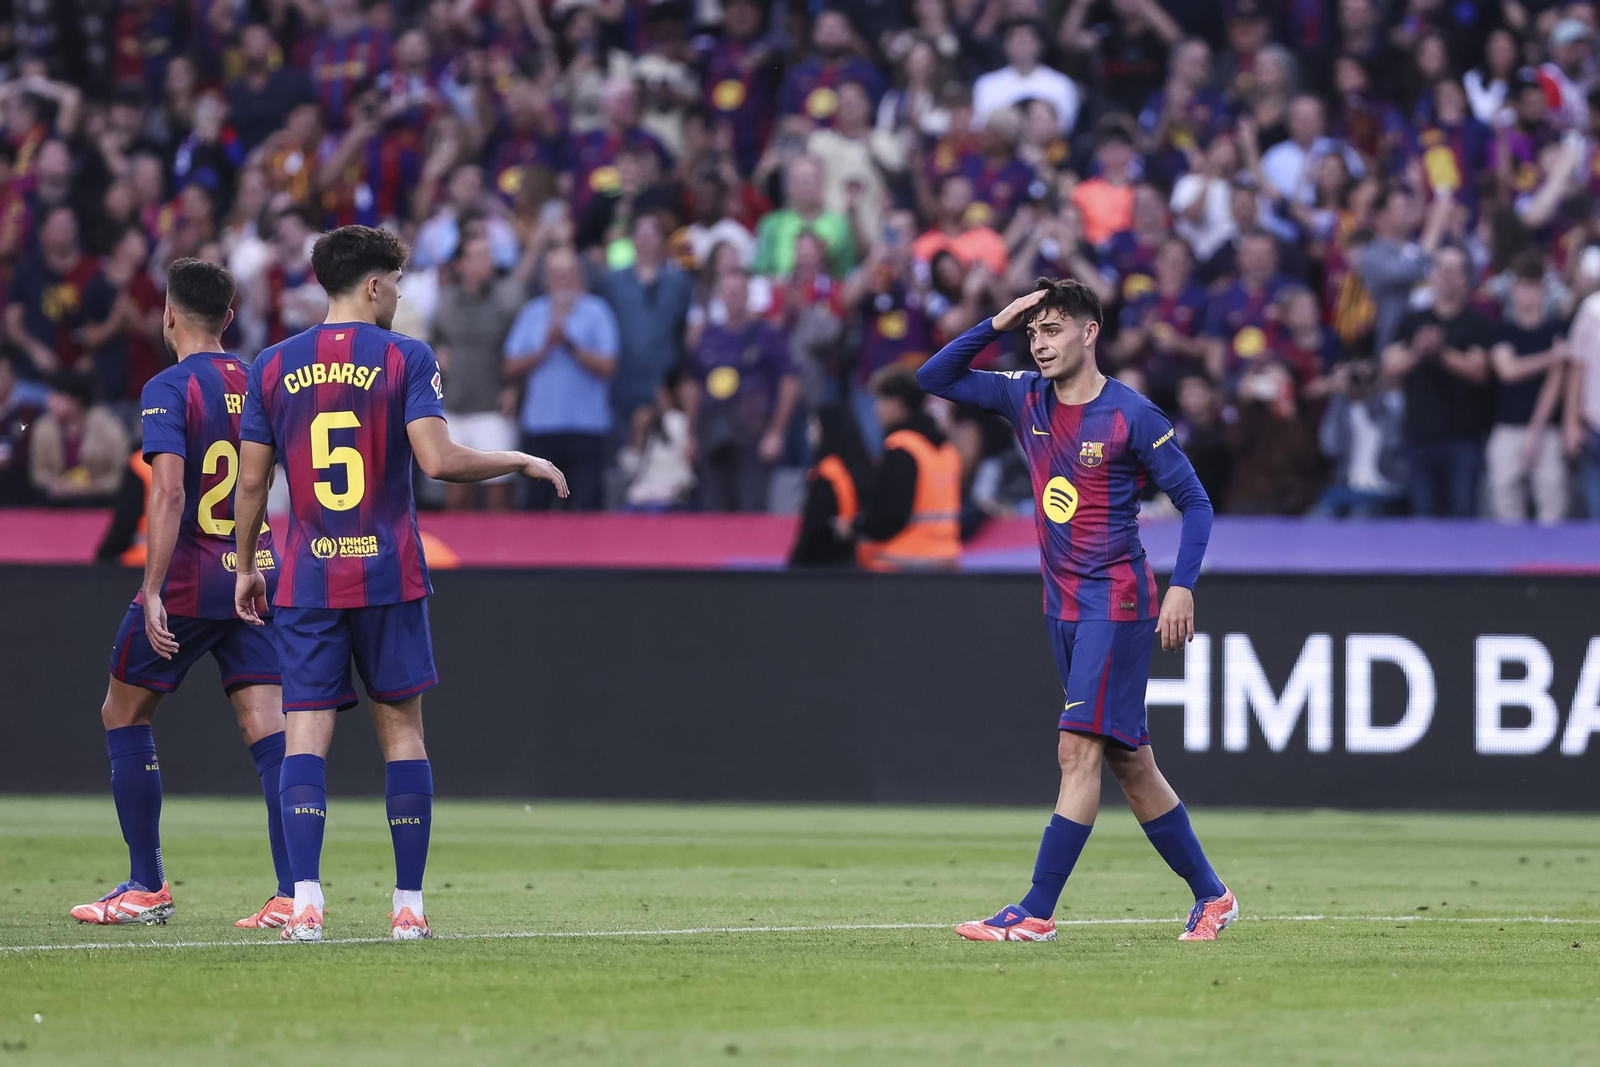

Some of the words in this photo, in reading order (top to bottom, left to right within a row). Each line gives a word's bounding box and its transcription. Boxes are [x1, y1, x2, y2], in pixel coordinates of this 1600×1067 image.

[283, 362, 382, 394] CUBARSÍ
[310, 411, 366, 512] 5
[338, 535, 377, 546] UNHCR
[339, 544, 379, 554] ACNUR
[1144, 631, 1438, 753] HMD
